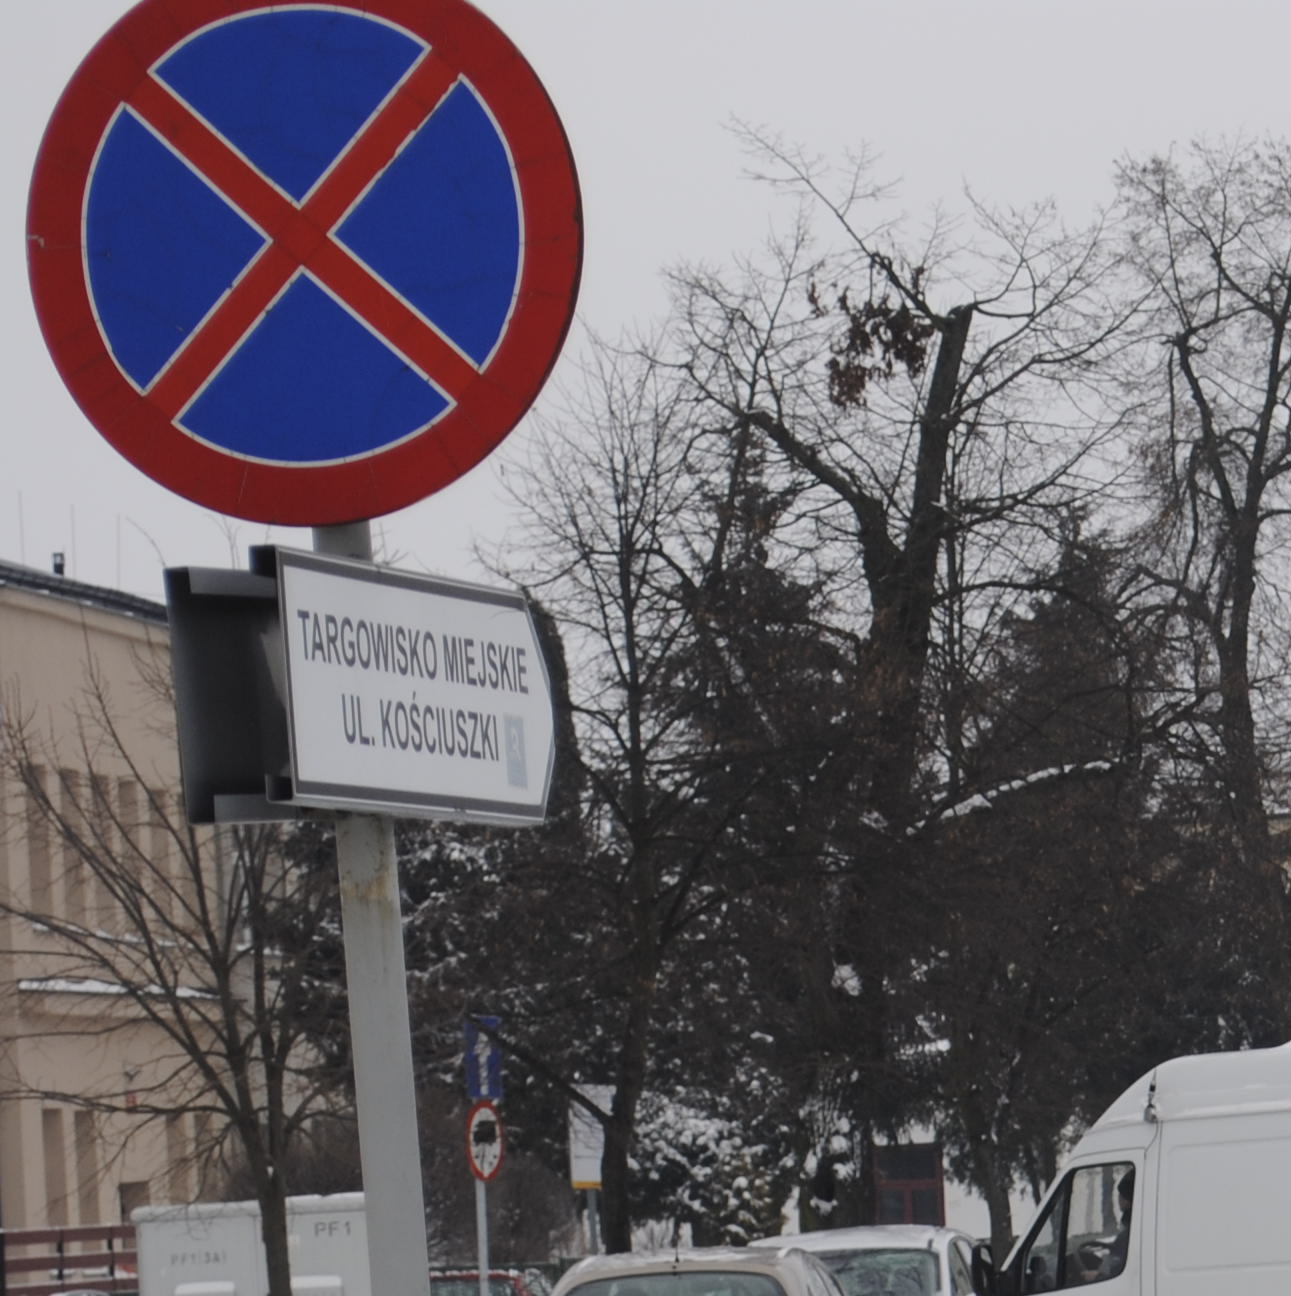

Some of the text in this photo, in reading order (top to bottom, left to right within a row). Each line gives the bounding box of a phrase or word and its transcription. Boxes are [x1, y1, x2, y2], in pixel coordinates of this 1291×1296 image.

[297, 609, 530, 695] TARGOWISKO MIEJSKIE
[341, 691, 500, 762] UL. KOŚCIUSZKI
